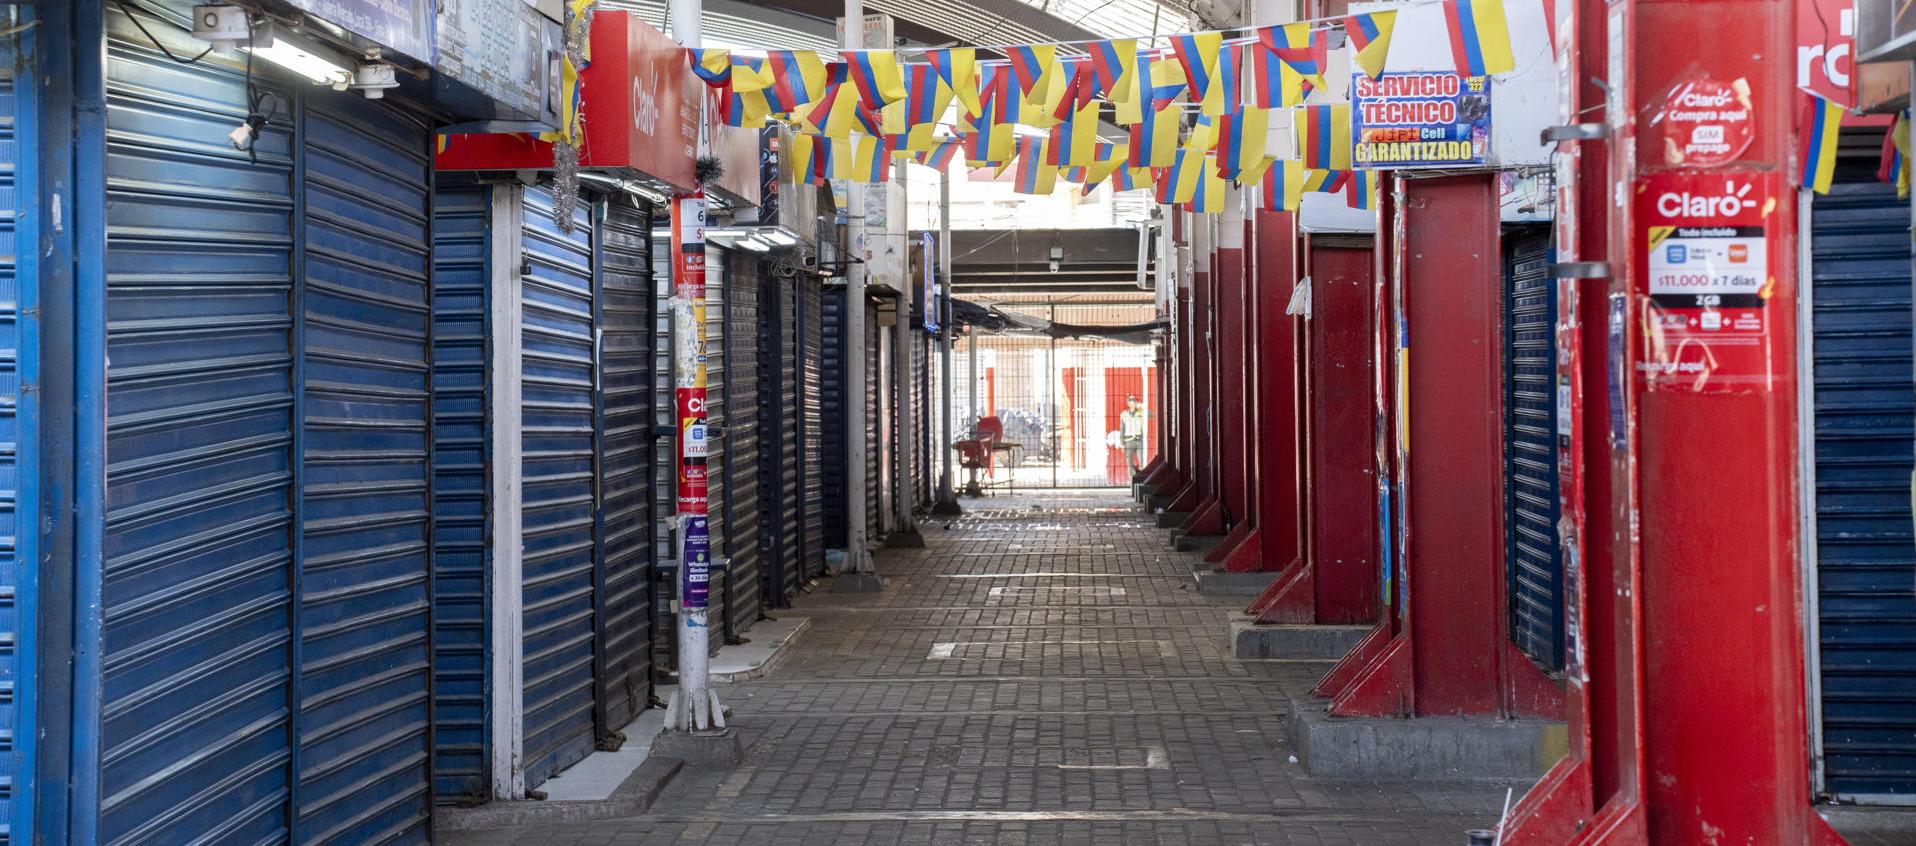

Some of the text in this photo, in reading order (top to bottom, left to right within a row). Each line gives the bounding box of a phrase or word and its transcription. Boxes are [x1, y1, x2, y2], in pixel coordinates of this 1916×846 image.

[1357, 74, 1459, 97] SERVICIO
[1684, 90, 1732, 107] Claro
[1362, 99, 1456, 125] TÉCNICO
[1669, 110, 1717, 122] Compra
[1355, 140, 1472, 162] GARANTIZADO
[1657, 187, 1750, 217] Claro
[1658, 275, 1709, 287] $11.000
